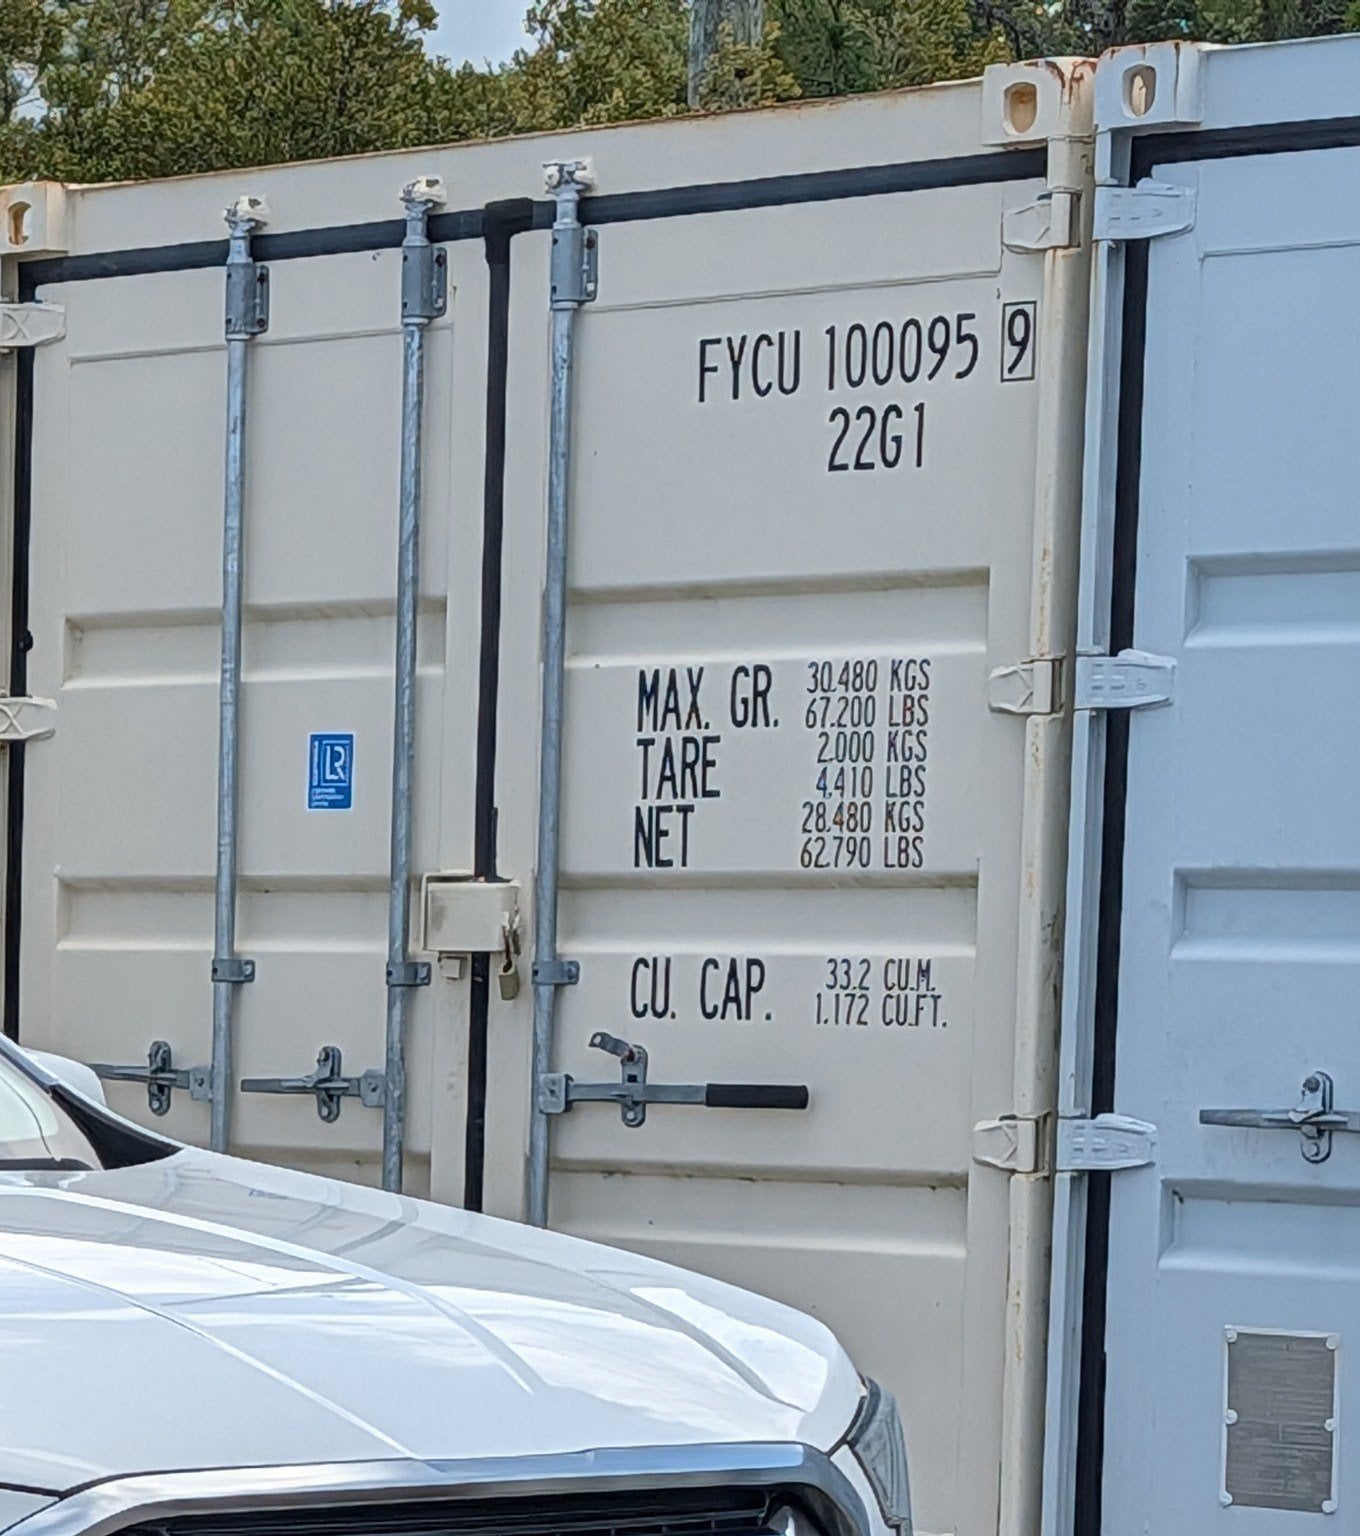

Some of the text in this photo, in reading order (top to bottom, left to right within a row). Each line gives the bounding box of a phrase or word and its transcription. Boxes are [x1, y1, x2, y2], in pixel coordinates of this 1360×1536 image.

[698, 307, 1031, 403] FYCU 100095 9
[827, 401, 925, 473] 22G1
[636, 658, 931, 733] MAX. GR. 30.480 KGS
[805, 694, 930, 729] 67.200 LBS
[636, 734, 721, 801] TARE
[886, 729, 928, 763] KGS
[885, 764, 927, 799] LBS
[633, 800, 925, 869] NET 28.480 KGS
[883, 835, 925, 869] LBS
[630, 956, 677, 1020] CU.
[699, 957, 772, 1021] CAP.
[825, 957, 871, 991] 33.2
[816, 992, 870, 1026] 1.172
